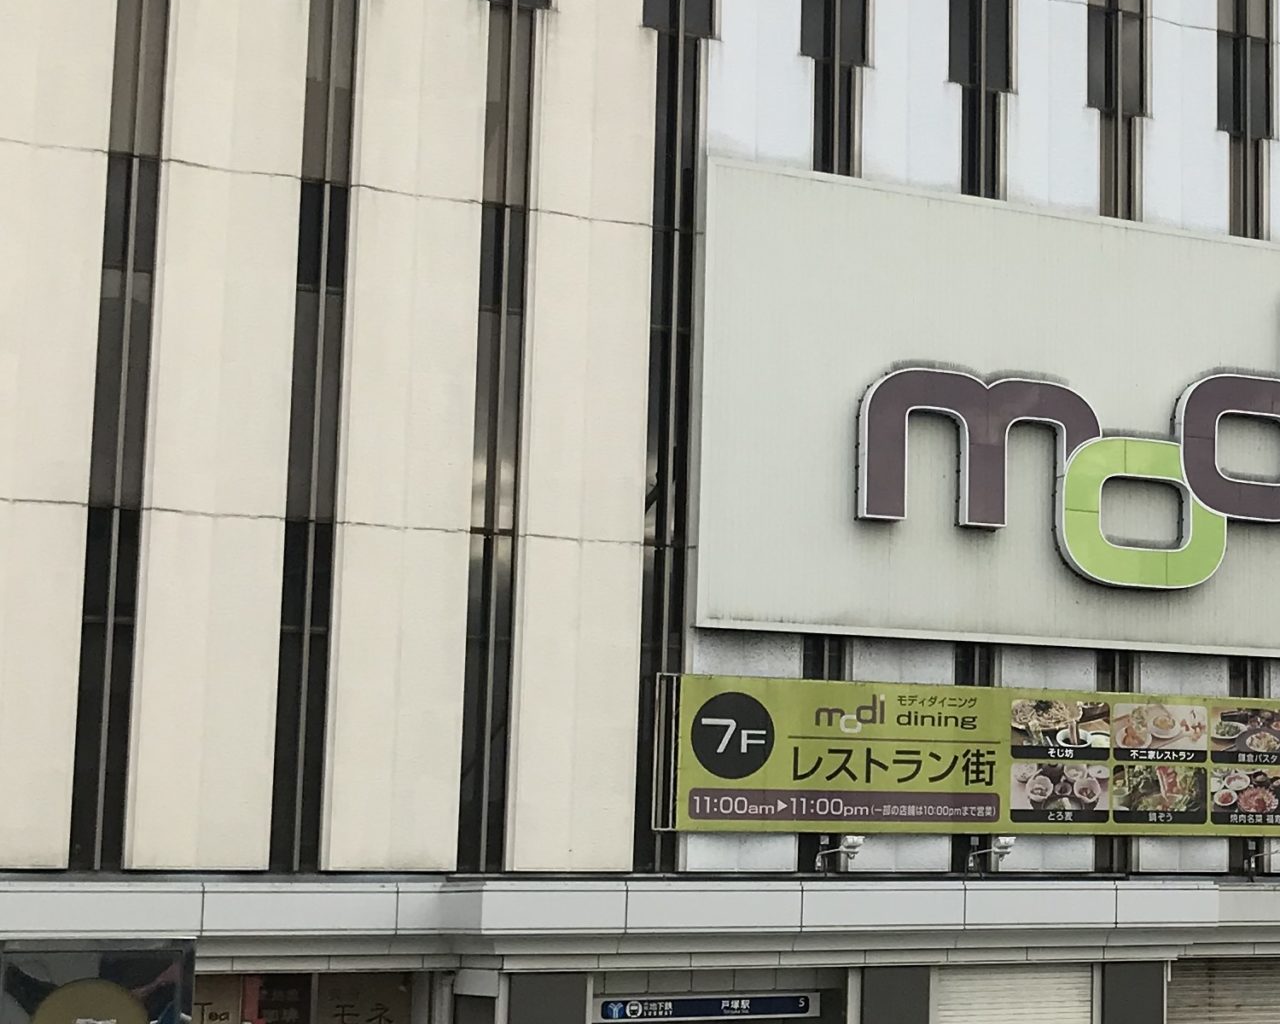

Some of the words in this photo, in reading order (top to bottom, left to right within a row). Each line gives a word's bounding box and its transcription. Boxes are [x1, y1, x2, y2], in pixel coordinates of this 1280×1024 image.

[897, 695, 978, 709] モディダイニング
[814, 694, 885, 734] modi
[897, 712, 977, 730] dining
[701, 718, 767, 754] 7F
[1047, 749, 1074, 759] そじ坊
[1130, 750, 1195, 761] 不二家レストラン
[791, 746, 995, 786] レストラン街
[693, 795, 775, 815] 11:00am
[790, 797, 870, 818] 11:00pm
[194, 1002, 230, 1022] Tea
